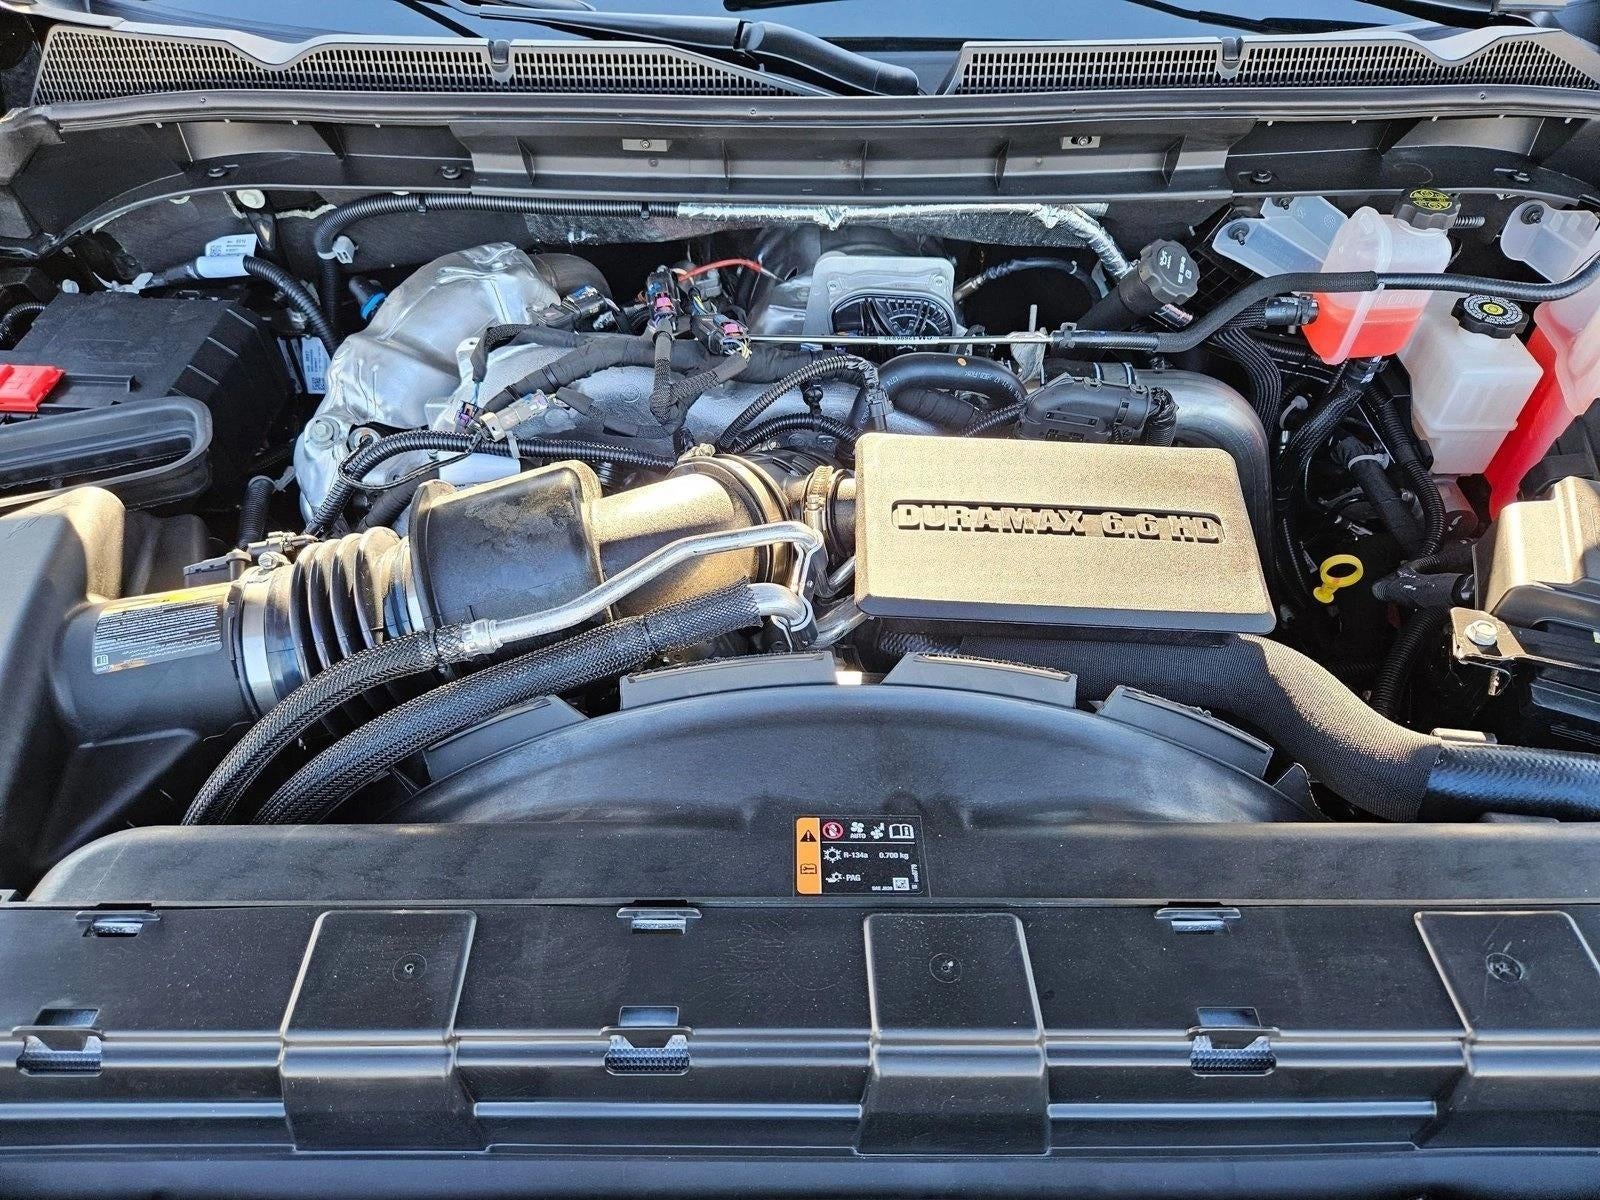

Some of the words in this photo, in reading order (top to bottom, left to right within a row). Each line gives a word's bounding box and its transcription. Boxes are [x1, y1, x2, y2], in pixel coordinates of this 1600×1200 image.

[897, 504, 1086, 536] DURAMAX
[1101, 511, 1161, 541] 6.6
[1167, 515, 1220, 544] HD
[900, 852, 909, 860] kg
[846, 874, 861, 882] PAG
